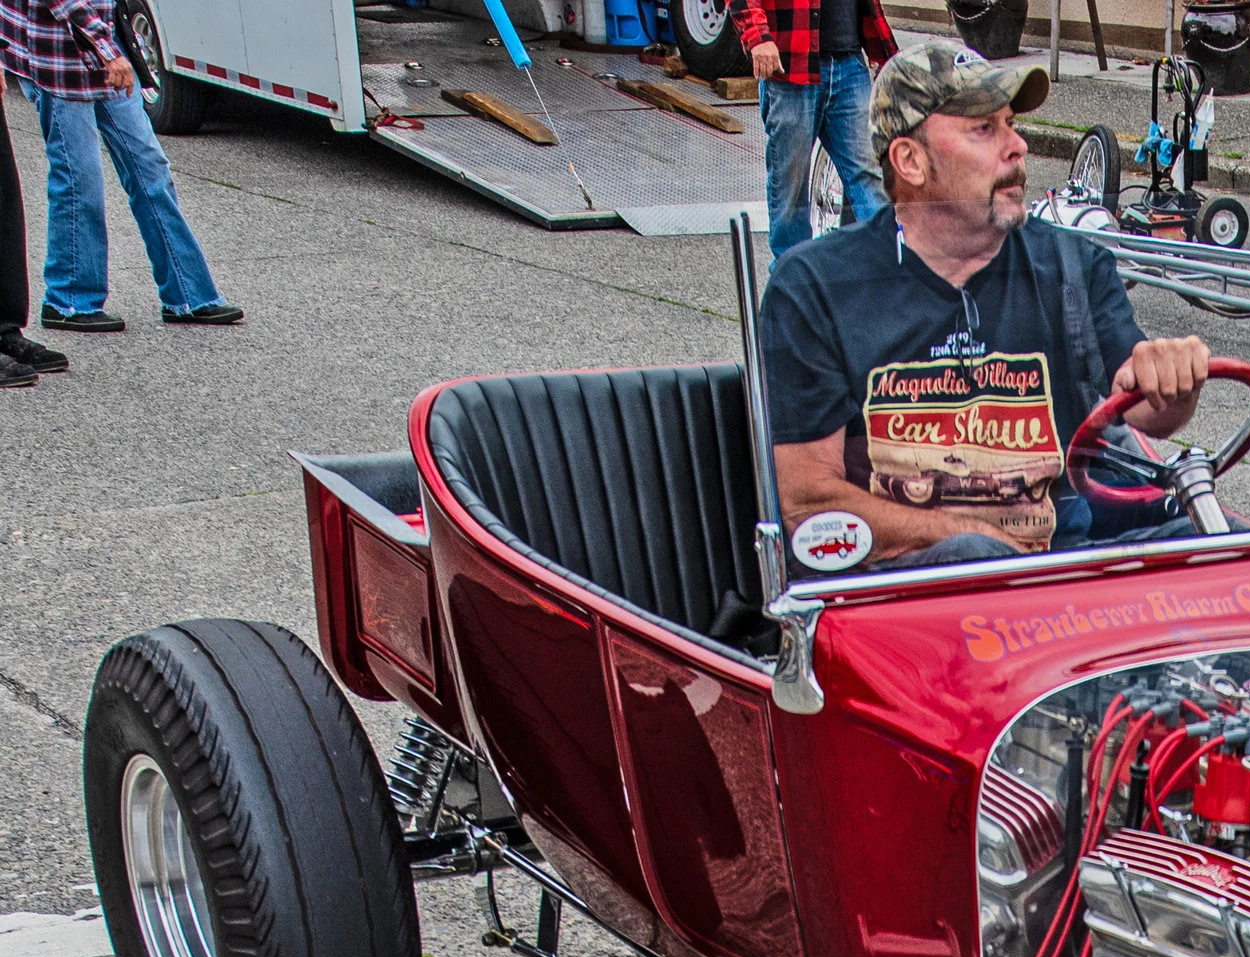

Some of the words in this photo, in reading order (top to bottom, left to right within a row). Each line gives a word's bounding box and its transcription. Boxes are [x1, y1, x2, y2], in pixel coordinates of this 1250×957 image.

[872, 368, 970, 403] Magnolia
[973, 361, 1041, 396] Village
[887, 413, 947, 443] Car
[960, 603, 1149, 663] Strawberry
[1144, 591, 1240, 622] Alarm
